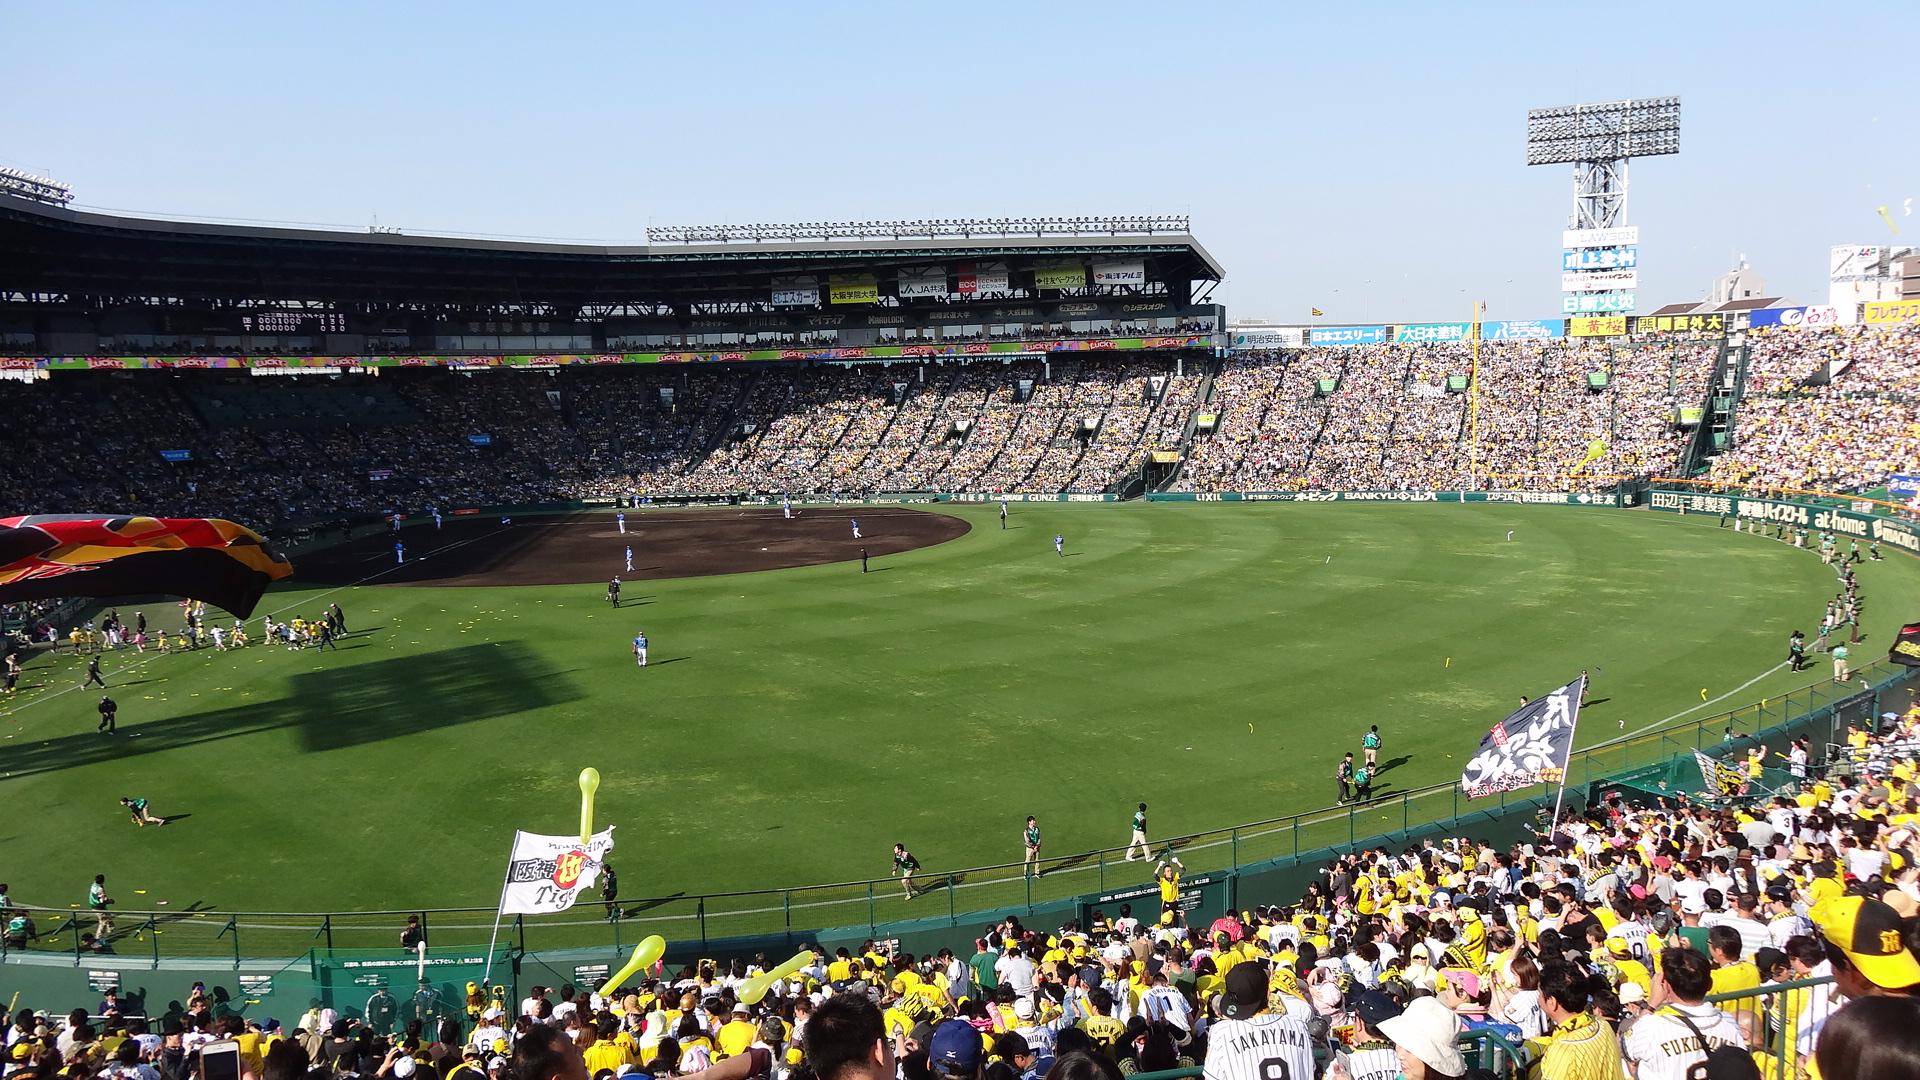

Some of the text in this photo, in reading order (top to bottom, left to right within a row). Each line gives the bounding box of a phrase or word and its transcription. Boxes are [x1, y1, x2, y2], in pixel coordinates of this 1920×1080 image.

[1580, 230, 1635, 243] LAWSON
[1042, 275, 1086, 286] 住友ベークライト
[831, 290, 877, 299] 大阪学院大学
[917, 285, 946, 294] JA共済
[783, 290, 819, 303] エスカーサ
[1586, 318, 1623, 334] 黄桜
[1247, 334, 1301, 344] 明治安田生命
[1312, 329, 1385, 342] 日本エスリード
[1403, 325, 1463, 341] 大日本塗料
[950, 493, 985, 502] 大和証券
[1028, 494, 1060, 502] GUNZE
[1196, 493, 1222, 501] LIXIL
[1294, 492, 1338, 502] オービック
[1344, 492, 1438, 502] SANKYU 山九
[1592, 494, 1616, 504] 住友
[1651, 492, 1732, 514] 田辺三菱製薬
[1737, 500, 1809, 525] 東進ハイスクール
[515, 860, 557, 881] 阪神
[1632, 942, 1644, 961] 0
[1162, 995, 1173, 1011] 1
[480, 1038, 490, 1051] 6
[1230, 1029, 1305, 1054] TAKAYAMA
